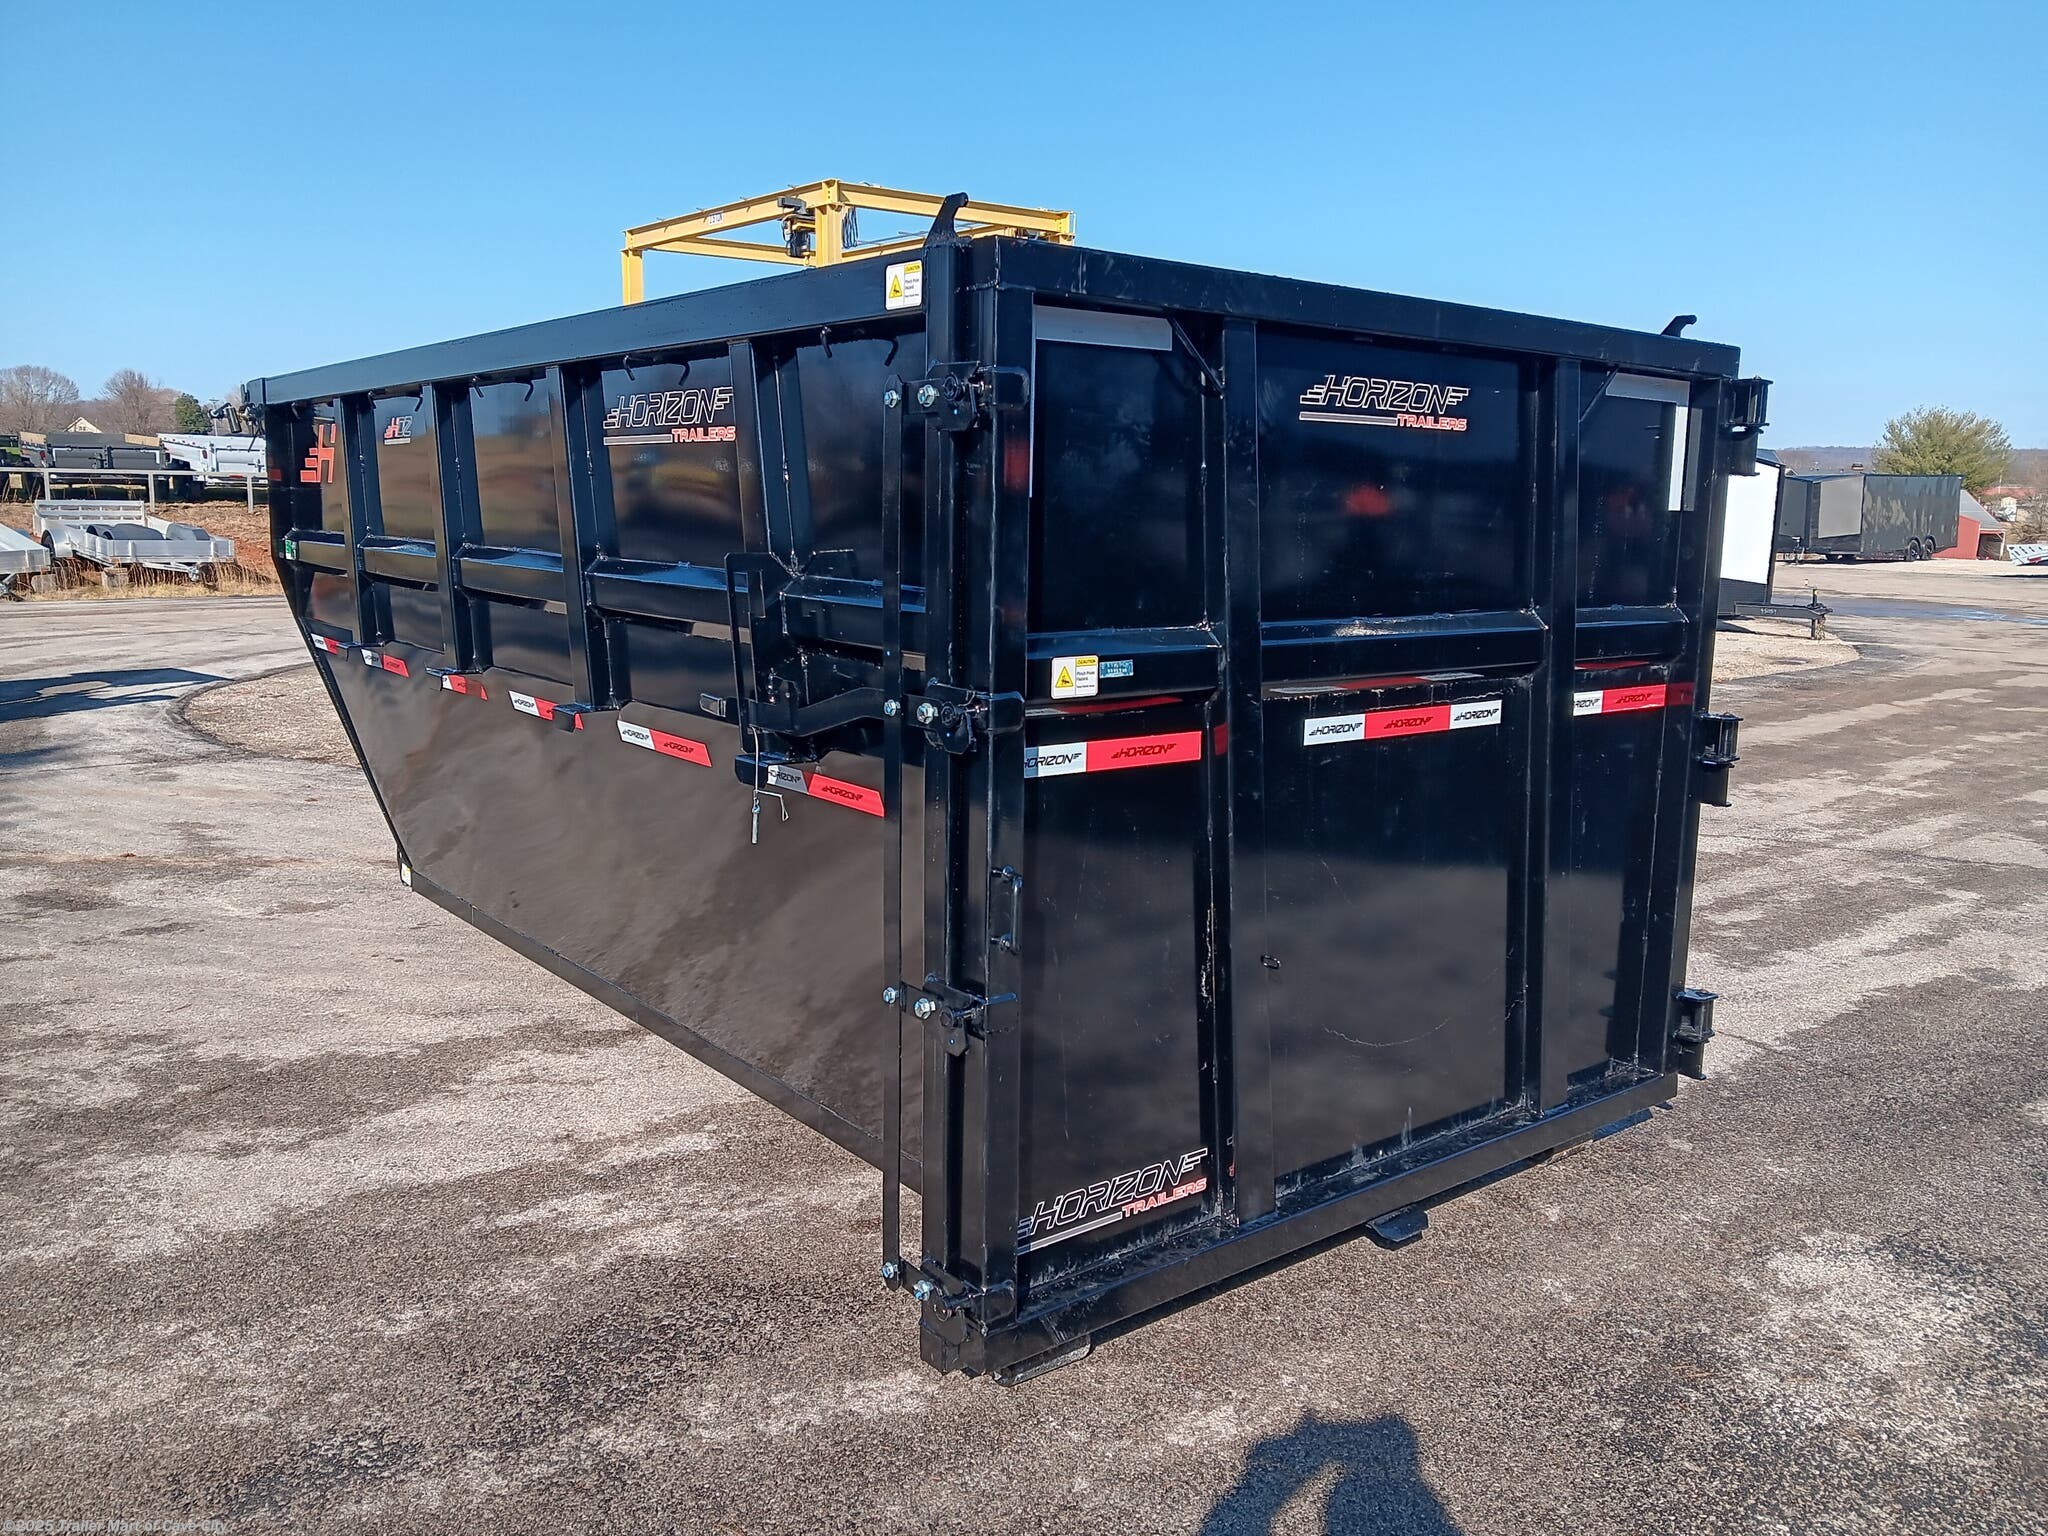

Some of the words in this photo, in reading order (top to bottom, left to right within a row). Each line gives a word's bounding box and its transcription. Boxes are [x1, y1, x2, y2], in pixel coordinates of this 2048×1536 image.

[615, 388, 719, 428] HORIZON
[1320, 374, 1453, 415] HORIZON
[671, 426, 736, 443] TRAILERS
[1397, 413, 1467, 431] TRAILERS
[1315, 723, 1358, 736] HORIZON
[1388, 716, 1429, 729] HORIZON
[1458, 708, 1495, 722] HORIZON
[1117, 743, 1170, 758] HORIZON
[1029, 1154, 1187, 1236] HORIZON
[1120, 1177, 1208, 1219] TRAILERS
